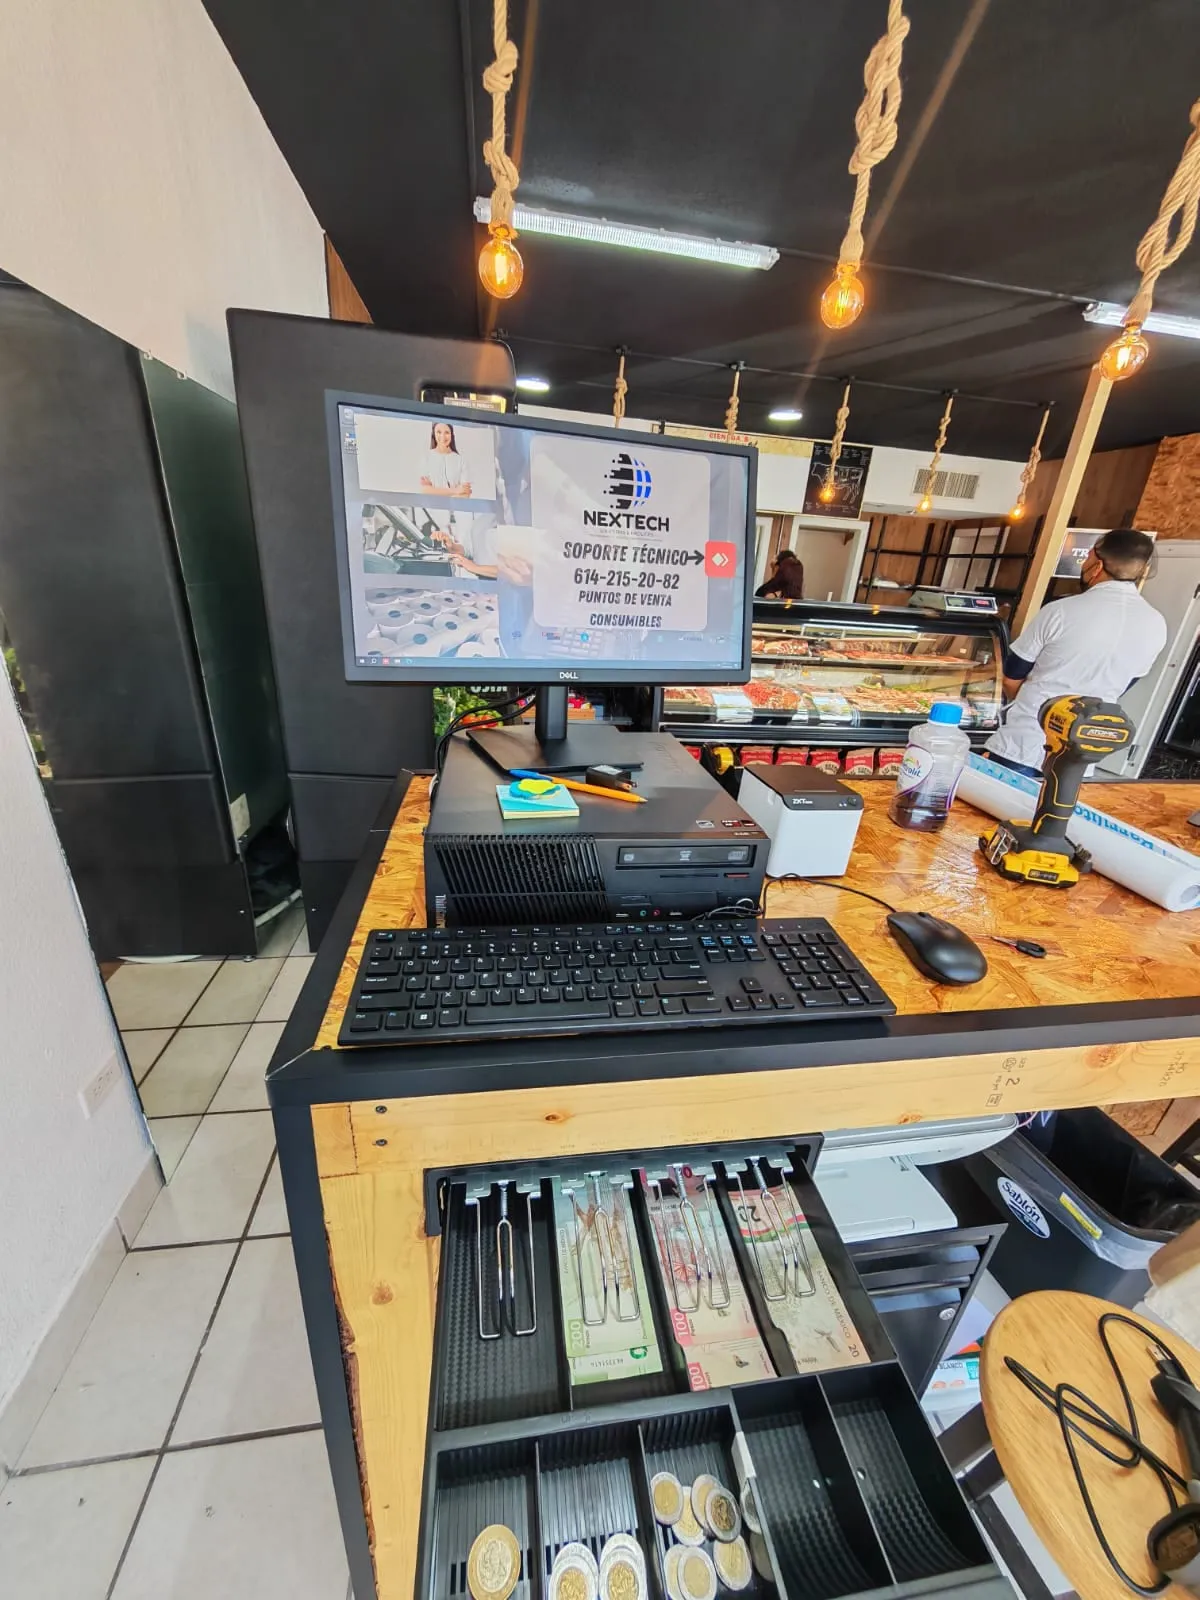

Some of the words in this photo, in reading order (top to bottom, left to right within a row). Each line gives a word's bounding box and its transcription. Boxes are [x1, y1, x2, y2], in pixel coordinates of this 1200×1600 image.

[583, 510, 670, 532] NEXTECH
[563, 541, 628, 562] SOPORTE
[632, 544, 688, 566] TÉCNICO
[574, 568, 680, 590] 614-215-20-82
[579, 590, 621, 605] PUNTOS
[624, 593, 637, 605] DE
[640, 593, 672, 607] VENTA
[590, 613, 662, 628] CONSUMIBLES
[1002, 1181, 1041, 1223] Sablón
[674, 1310, 690, 1338] 100
[570, 1321, 582, 1351] 200
[847, 1343, 860, 1358] 20
[689, 1366, 706, 1391] 100
